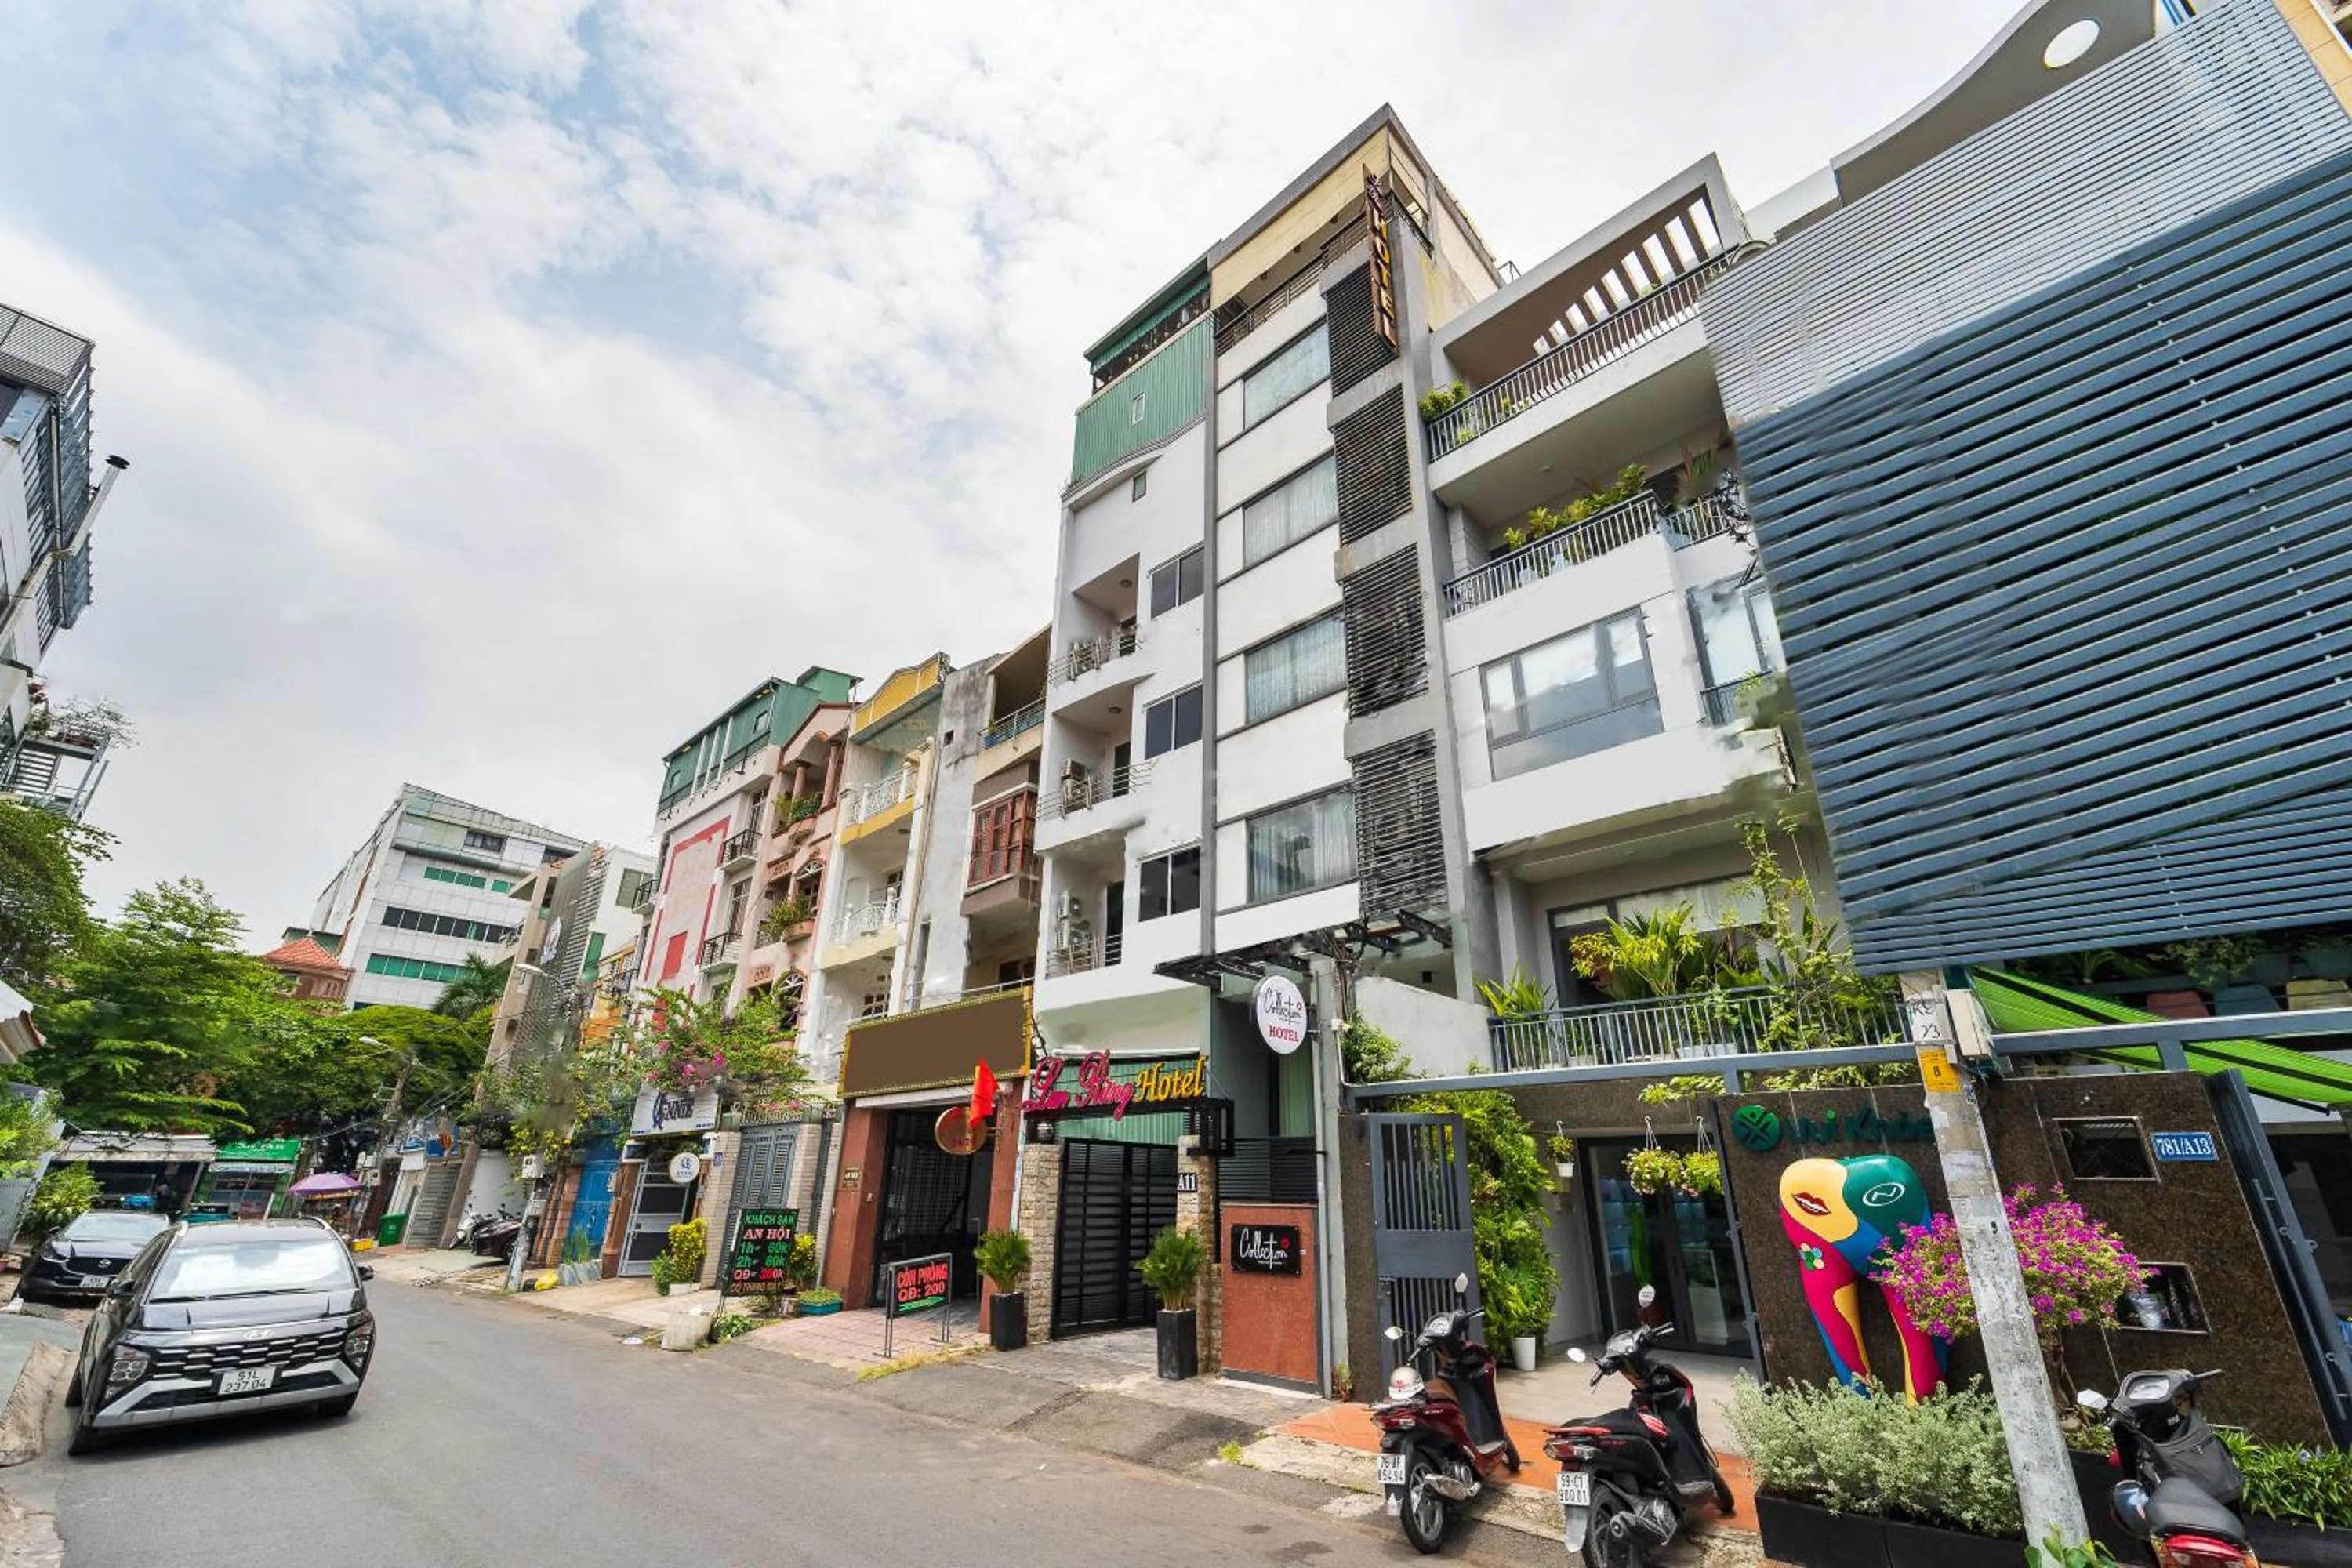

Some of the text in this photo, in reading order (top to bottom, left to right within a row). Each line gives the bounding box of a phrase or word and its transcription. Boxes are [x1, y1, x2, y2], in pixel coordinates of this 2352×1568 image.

[1372, 207, 1396, 347] HOTEL
[1269, 1025, 1299, 1042] HOTEL
[1134, 1054, 1207, 1102] Hotel
[2156, 1138, 2211, 1155] 781/A13
[1178, 1174, 1196, 1190] A11
[743, 1229, 764, 1239] AN
[1240, 1227, 1287, 1270] Collection
[924, 1280, 945, 1296] 200
[238, 1370, 260, 1381] 51L
